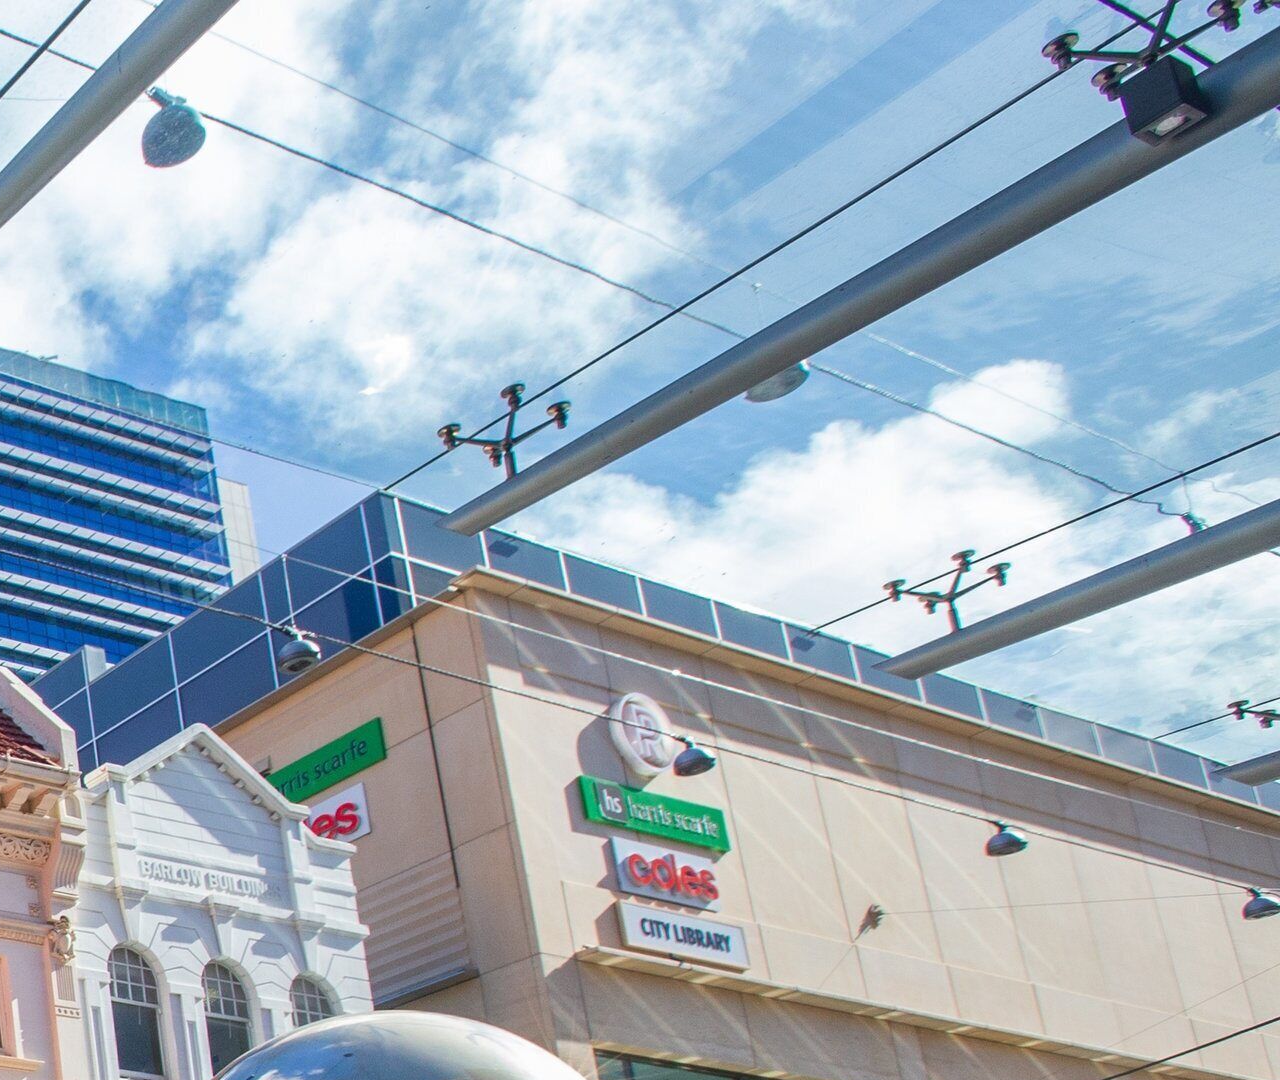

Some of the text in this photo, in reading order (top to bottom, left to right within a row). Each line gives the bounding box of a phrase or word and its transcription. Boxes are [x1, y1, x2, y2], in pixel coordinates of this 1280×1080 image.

[276, 739, 369, 797] rris scarfe
[603, 788, 624, 814] hs
[628, 797, 720, 838] harris scarfe
[138, 859, 204, 888] BARLOW
[627, 852, 720, 902] coles
[641, 918, 731, 954] CITY LIBRARY
